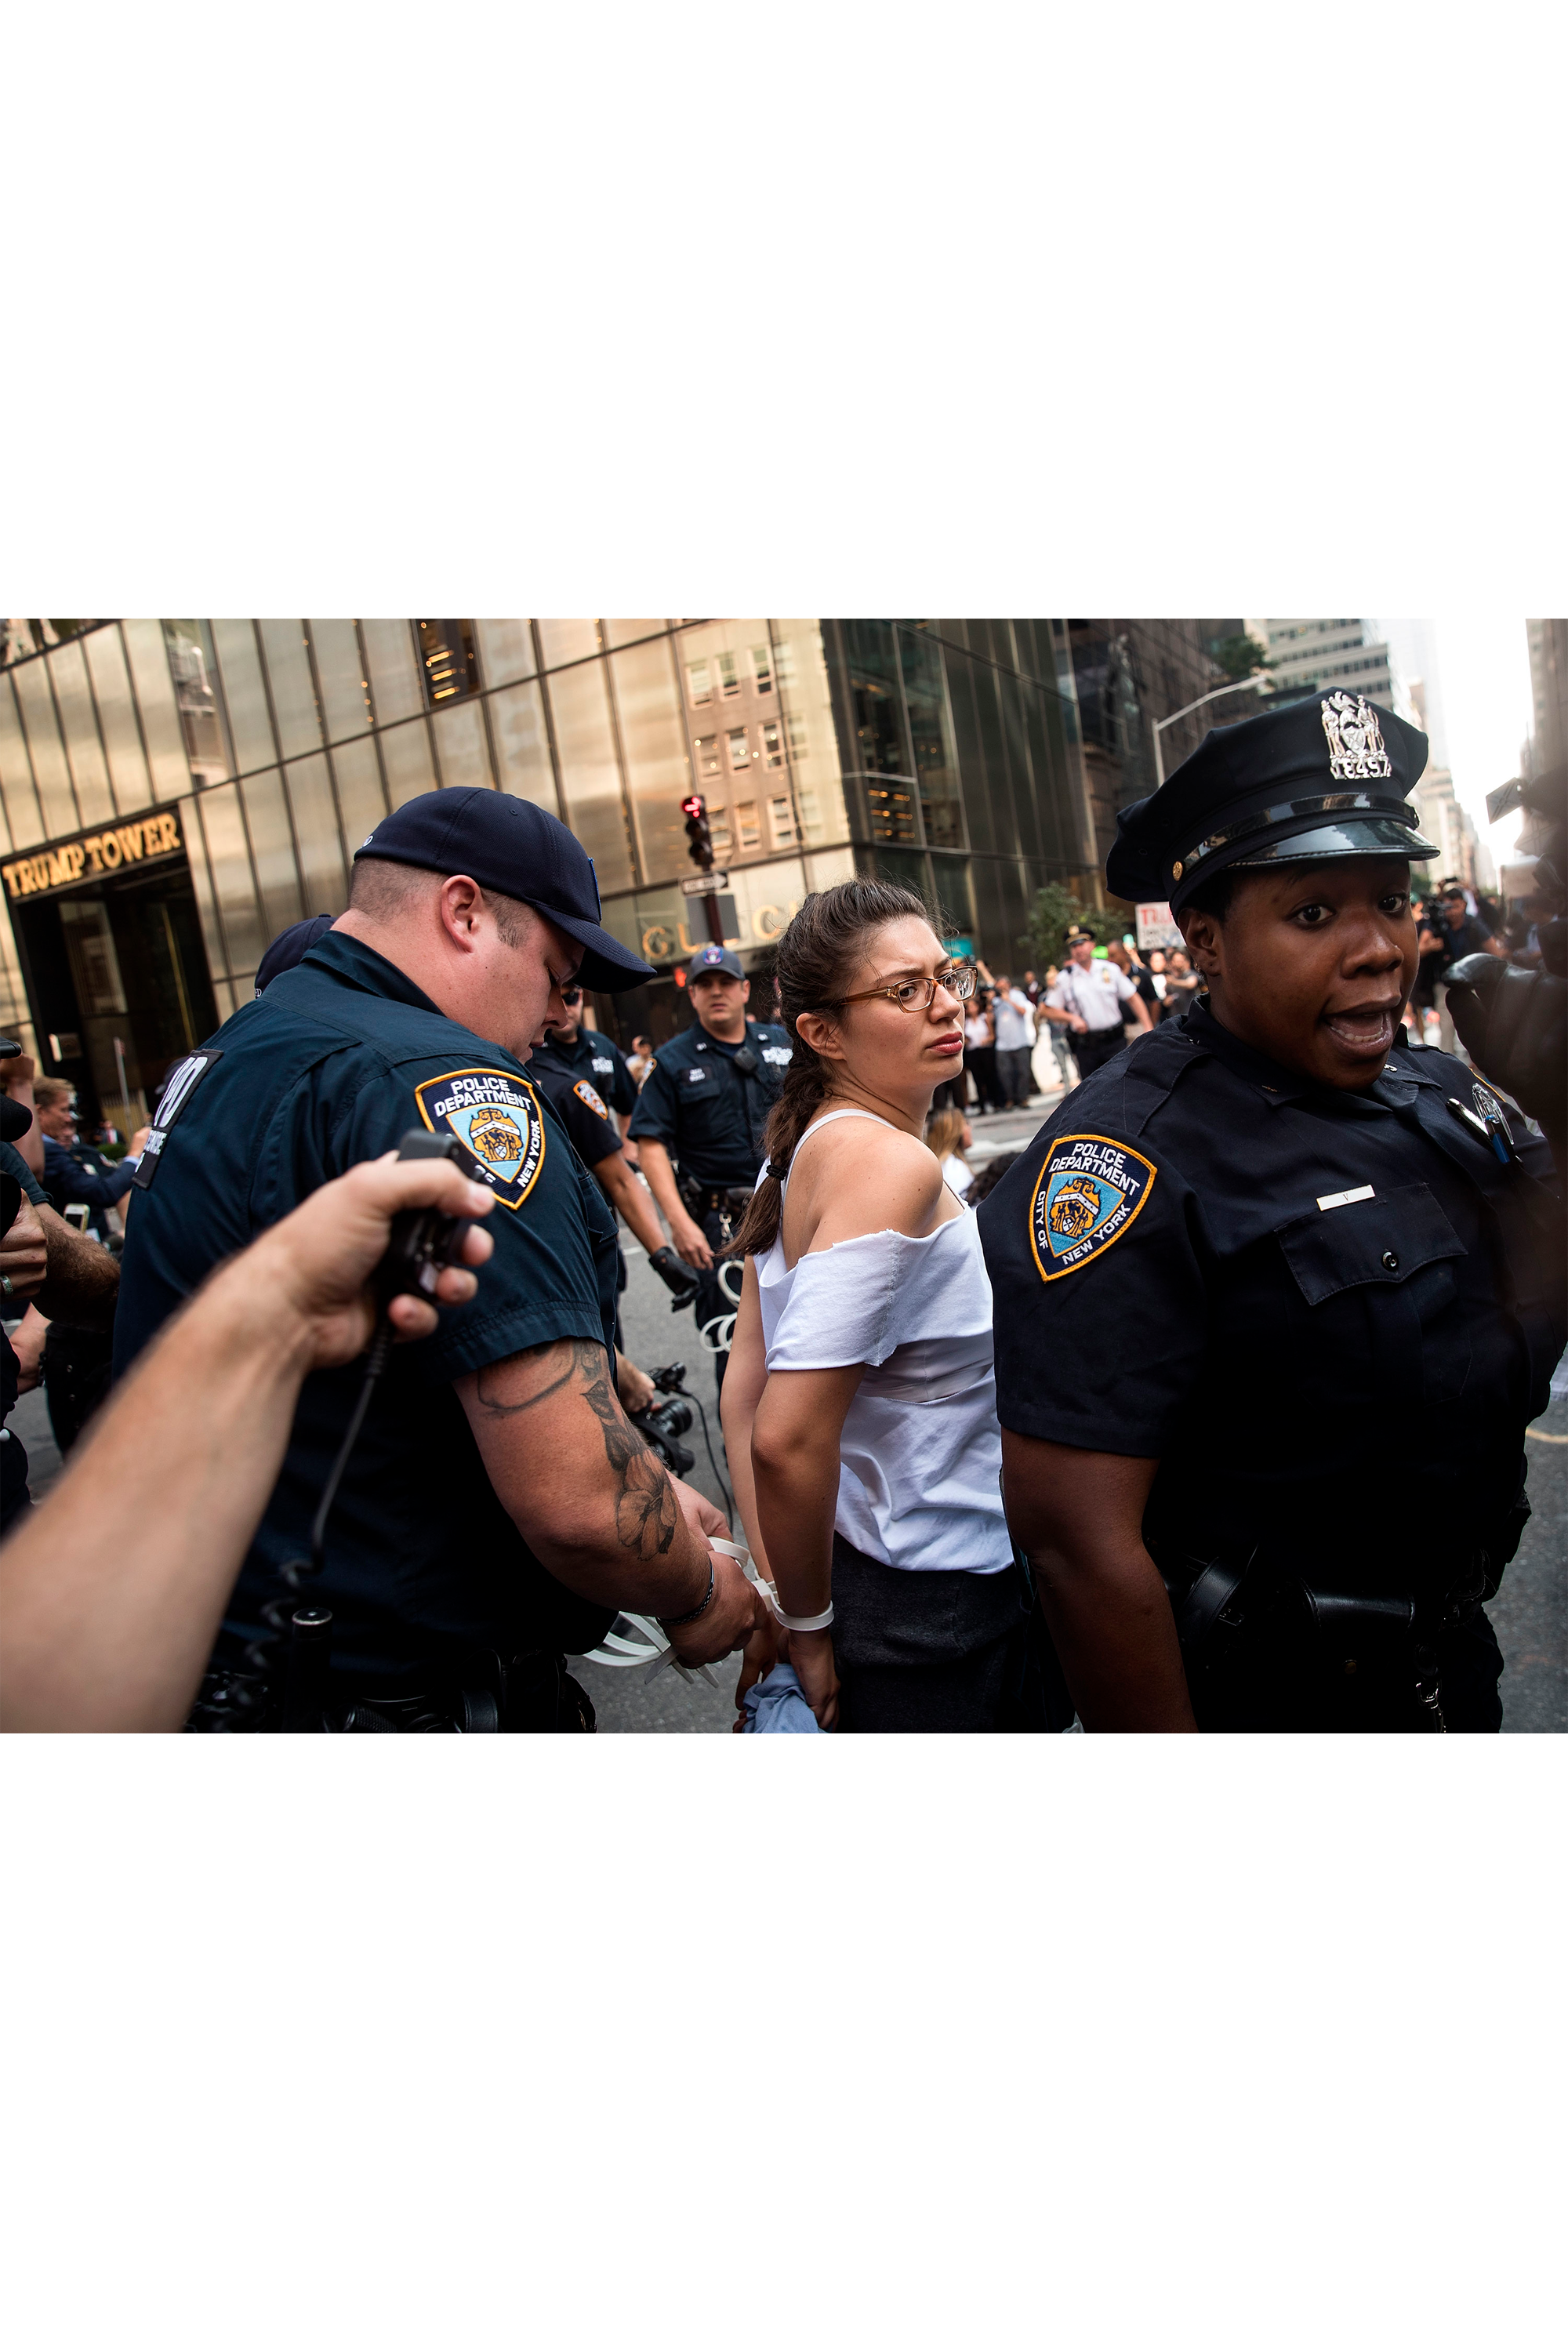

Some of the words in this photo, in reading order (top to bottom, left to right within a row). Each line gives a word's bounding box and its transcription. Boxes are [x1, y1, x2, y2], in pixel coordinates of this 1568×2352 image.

[2, 842, 85, 898] TRUMP
[84, 812, 181, 872] TOWER
[450, 1077, 510, 1095] POLICE
[434, 1089, 532, 1118] DEPARTMENT
[517, 1157, 536, 1188] NEW
[528, 1120, 541, 1157] YORK
[1071, 1143, 1127, 1170] POLICE
[1048, 1156, 1141, 1196] DEPARTMENT
[1036, 1190, 1047, 1225] CITY
[1093, 1203, 1131, 1241] YORK
[1037, 1229, 1049, 1250] OF
[1062, 1240, 1094, 1265] NEW
